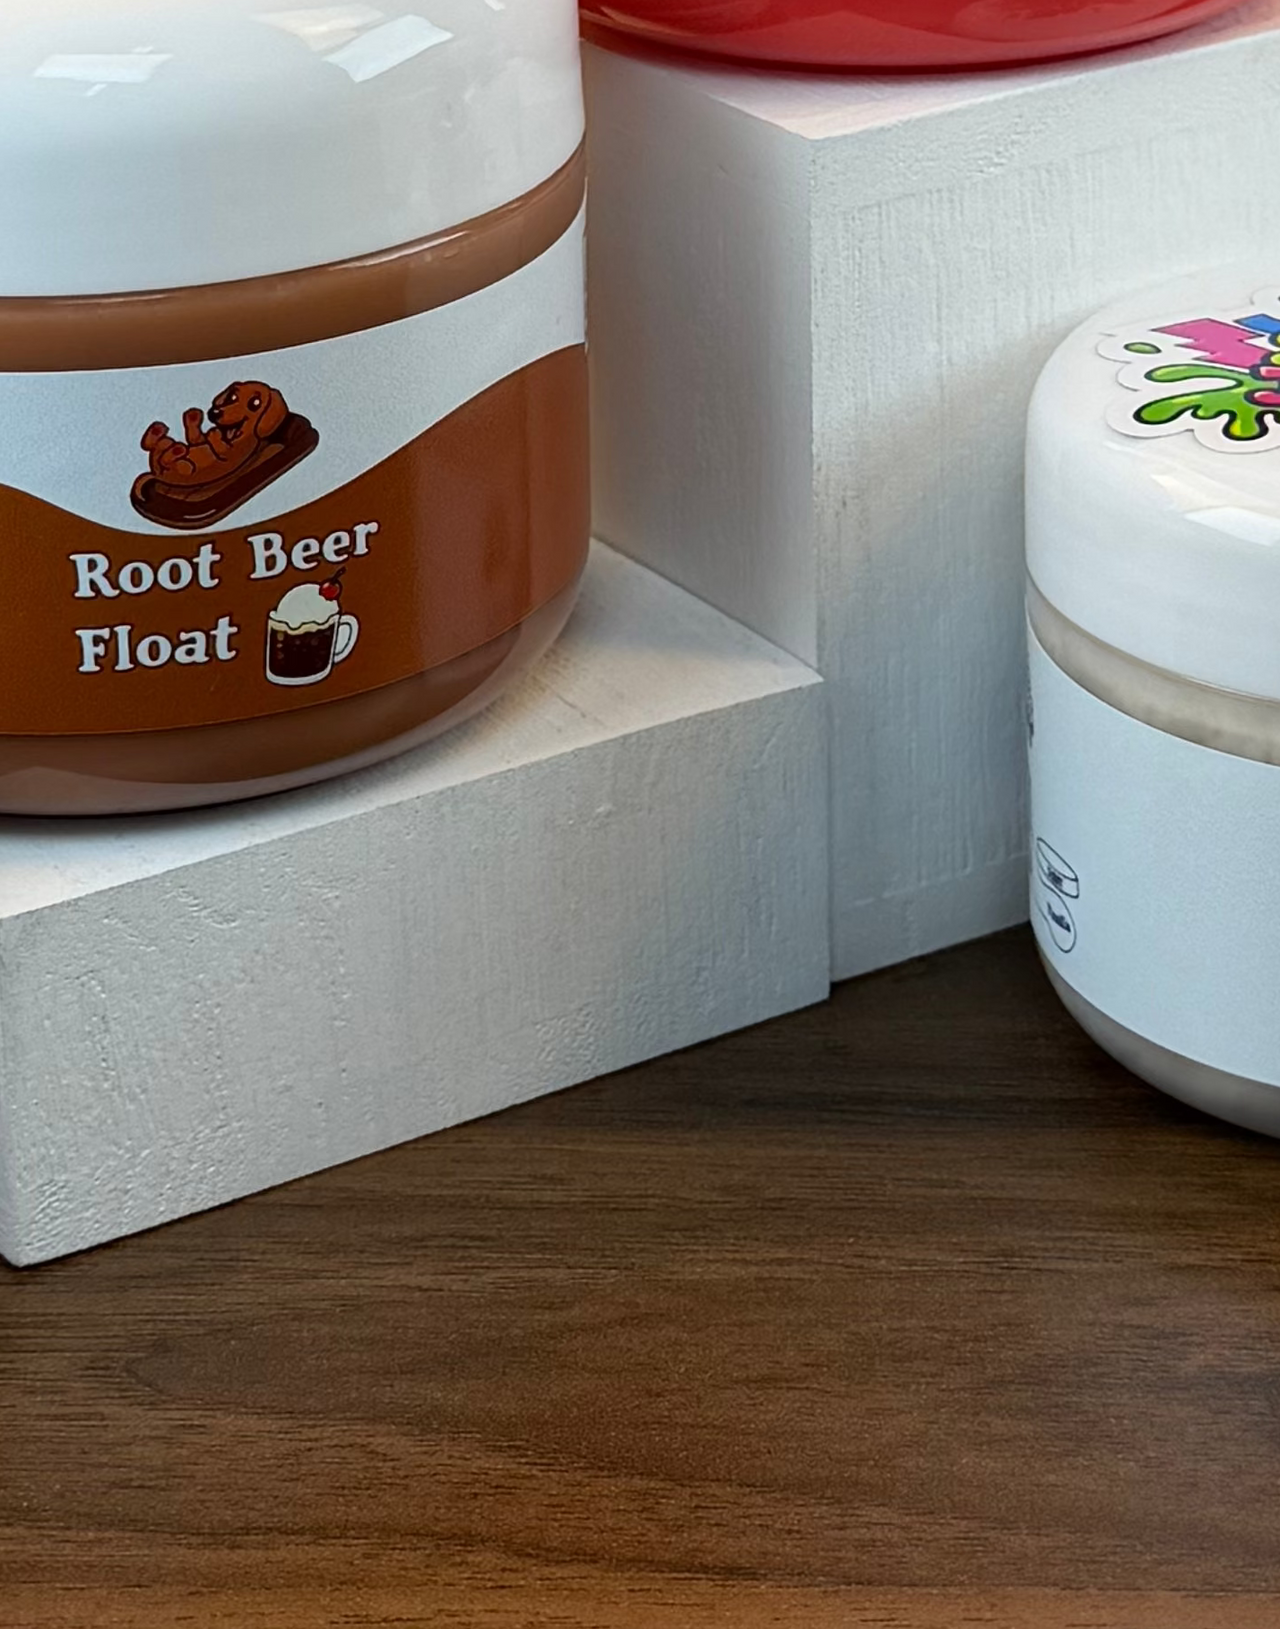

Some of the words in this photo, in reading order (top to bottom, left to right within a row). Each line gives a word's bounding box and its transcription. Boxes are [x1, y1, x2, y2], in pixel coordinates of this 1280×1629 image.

[69, 543, 221, 599] Root
[247, 521, 380, 580] Beer
[75, 616, 239, 673] Float
